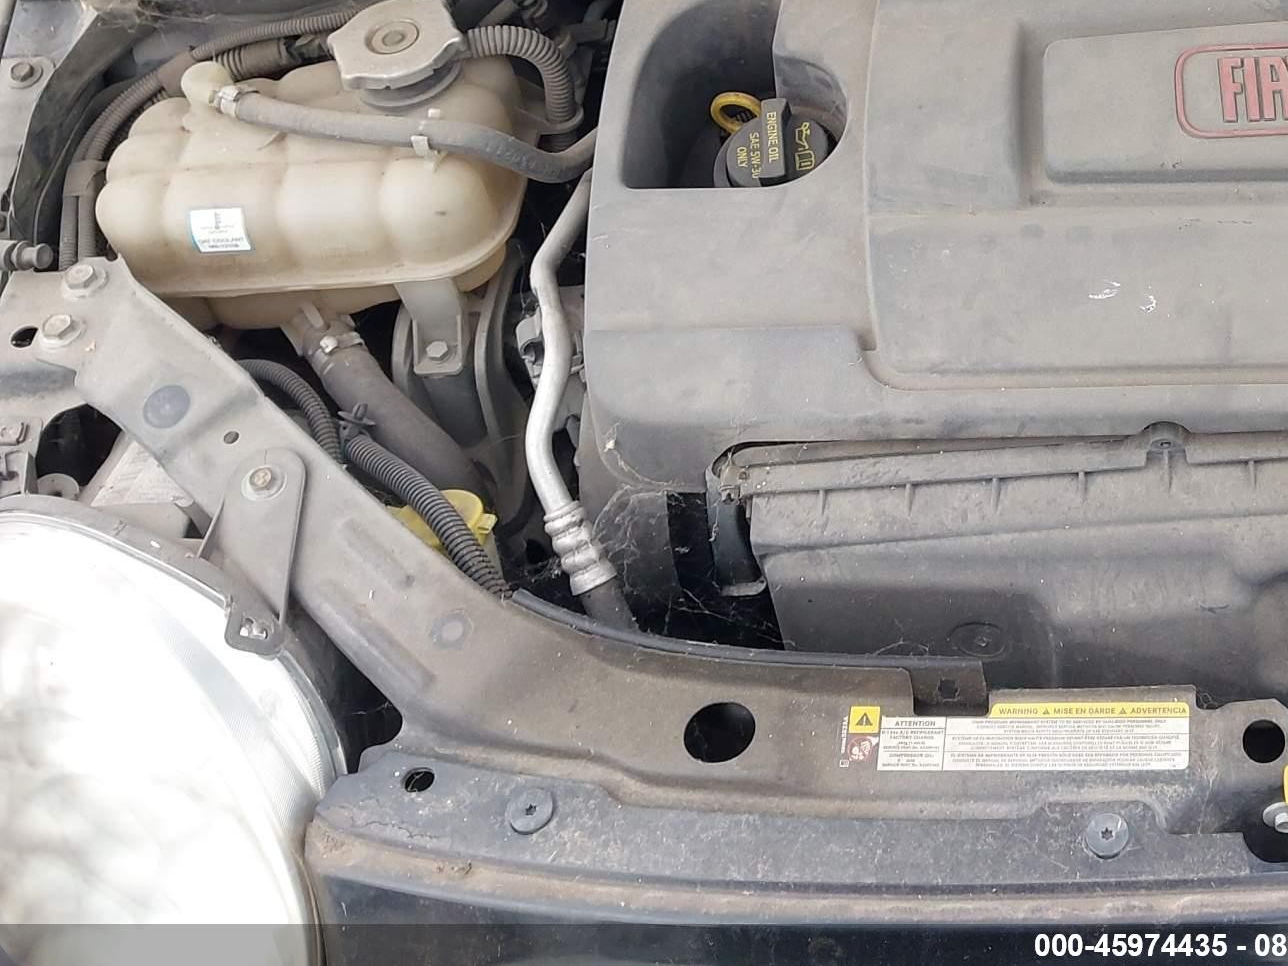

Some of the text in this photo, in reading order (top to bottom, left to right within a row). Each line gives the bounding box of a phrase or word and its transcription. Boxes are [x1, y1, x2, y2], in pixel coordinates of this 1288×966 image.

[736, 146, 748, 168] ONLY
[749, 132, 761, 179] SAE 5W-30
[766, 111, 779, 163] ENGINE OIL
